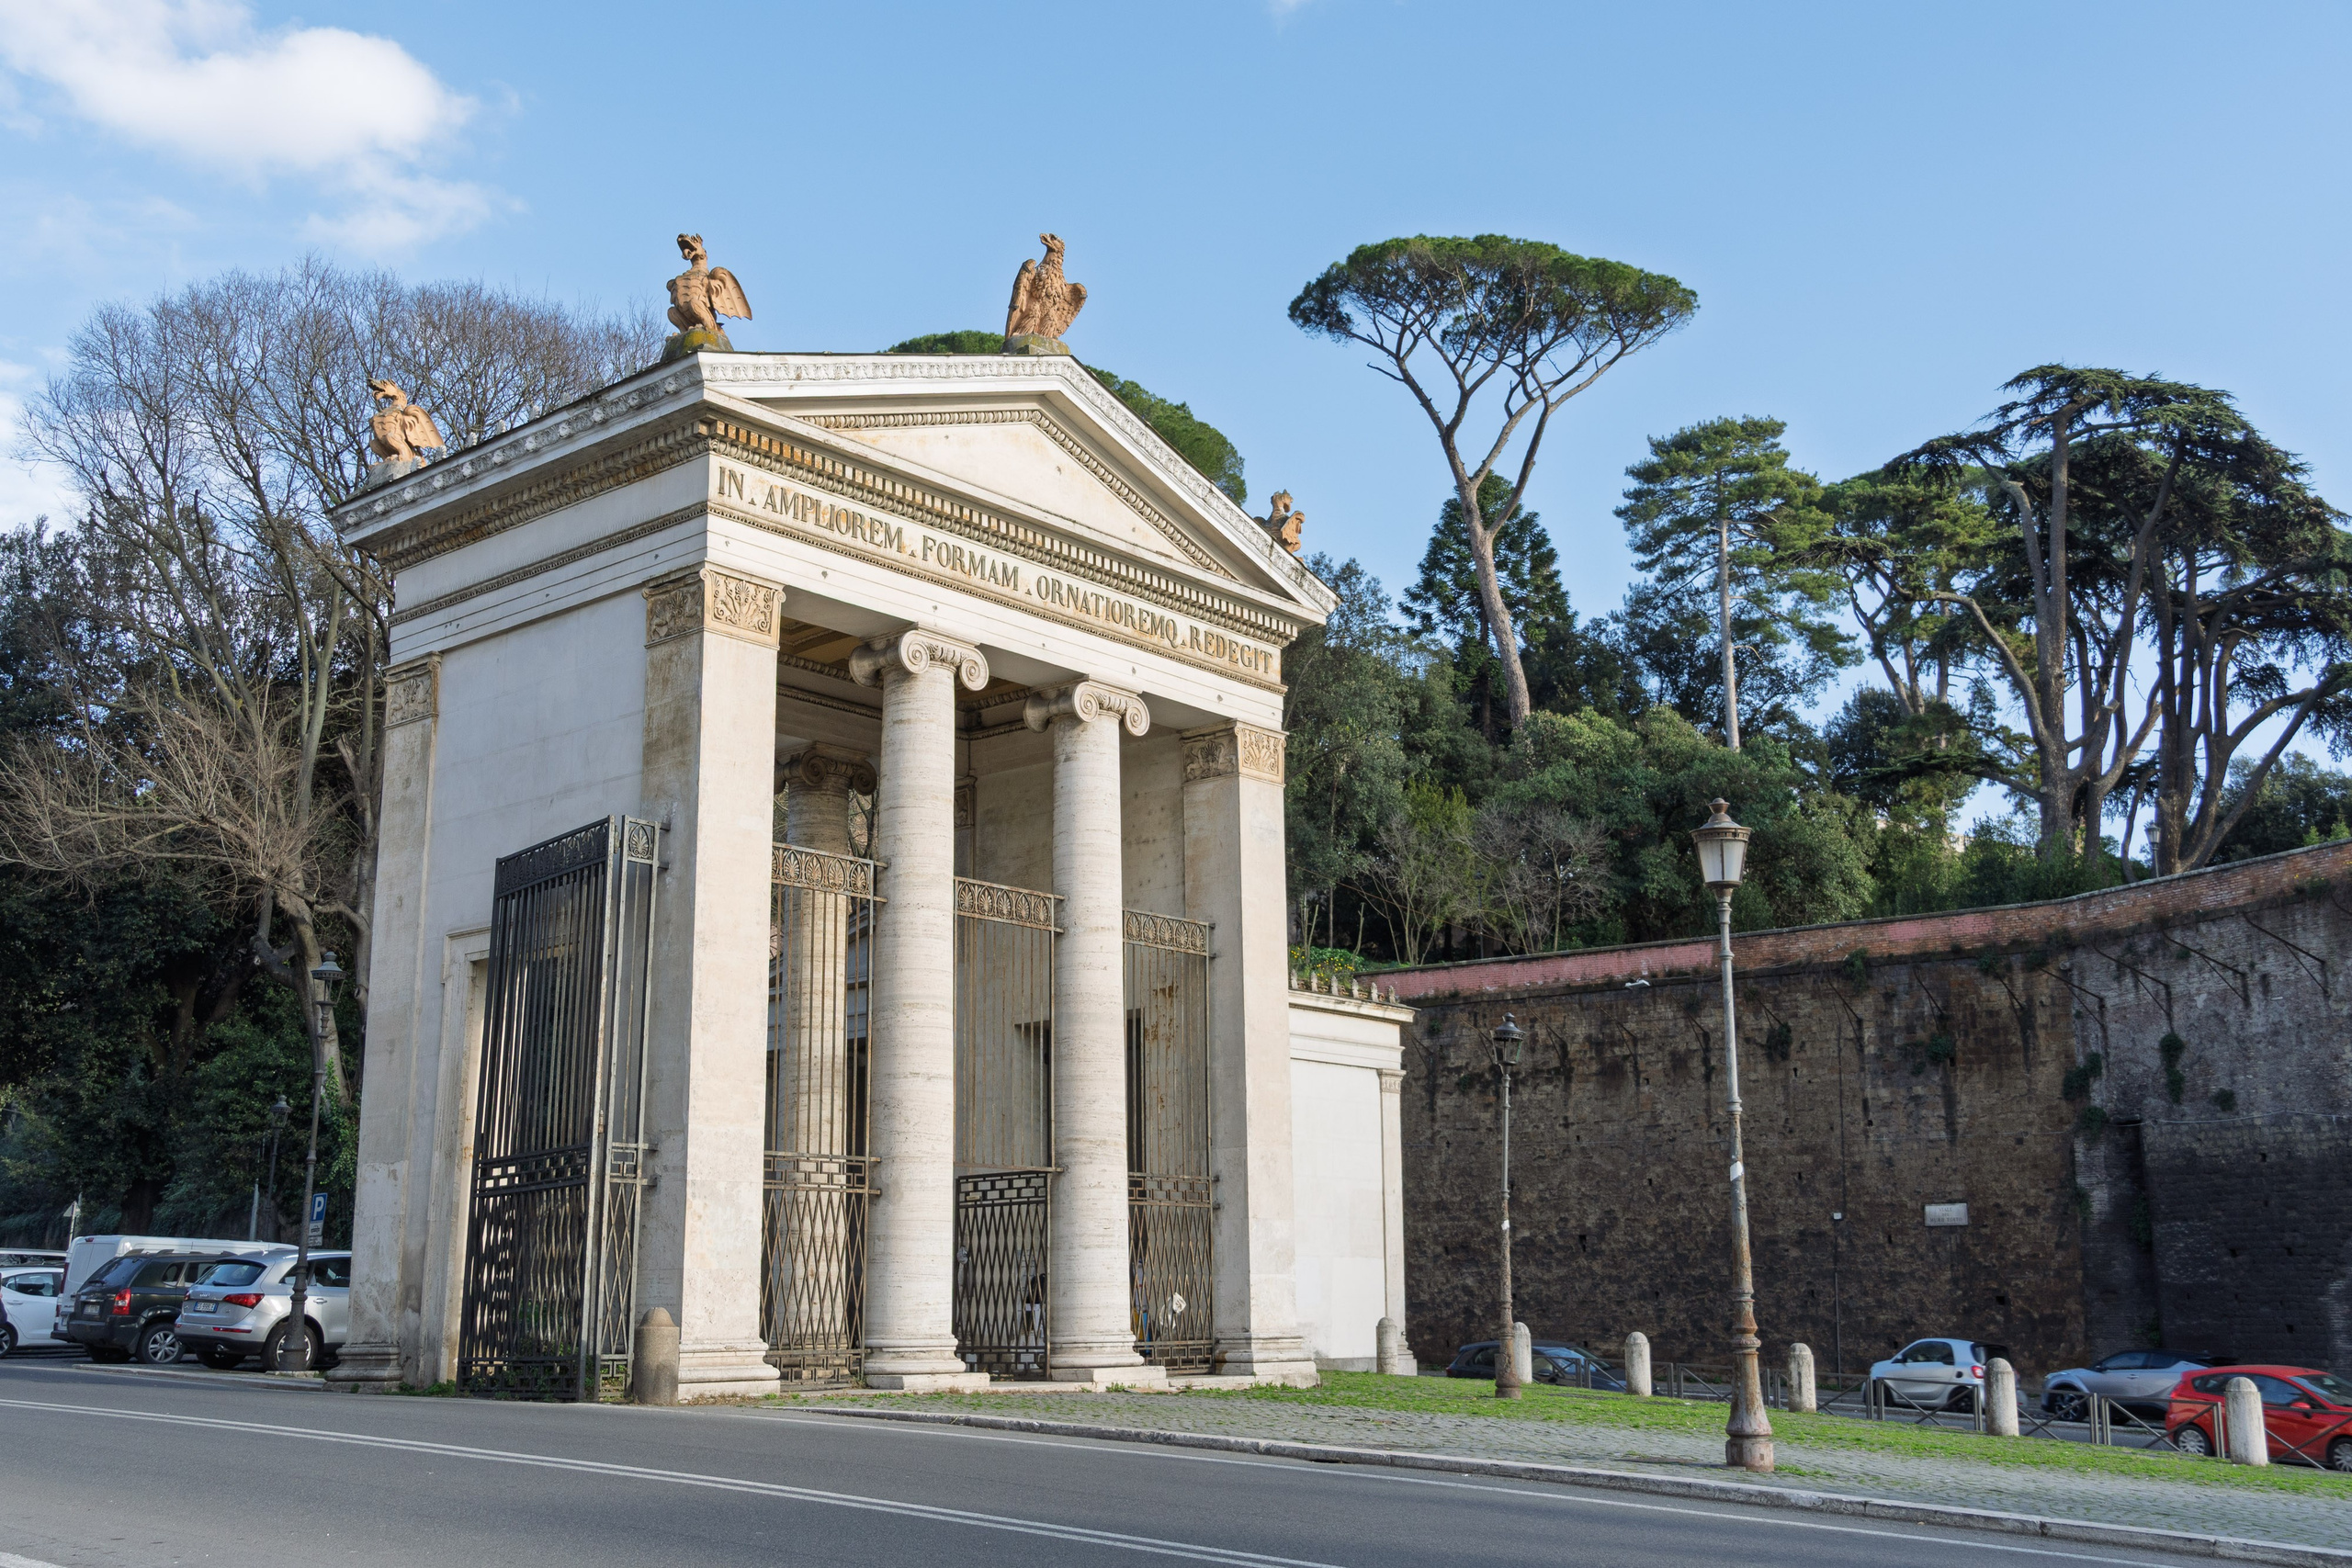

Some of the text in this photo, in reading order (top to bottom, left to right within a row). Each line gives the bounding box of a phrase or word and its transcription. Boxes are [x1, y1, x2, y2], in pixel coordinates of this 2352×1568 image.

[717, 466, 745, 501] IN
[763, 484, 904, 553] AMPLIOREM
[922, 535, 1020, 592] FORMAM
[1189, 625, 1273, 674] REDEGIT
[312, 1196, 324, 1220] P
